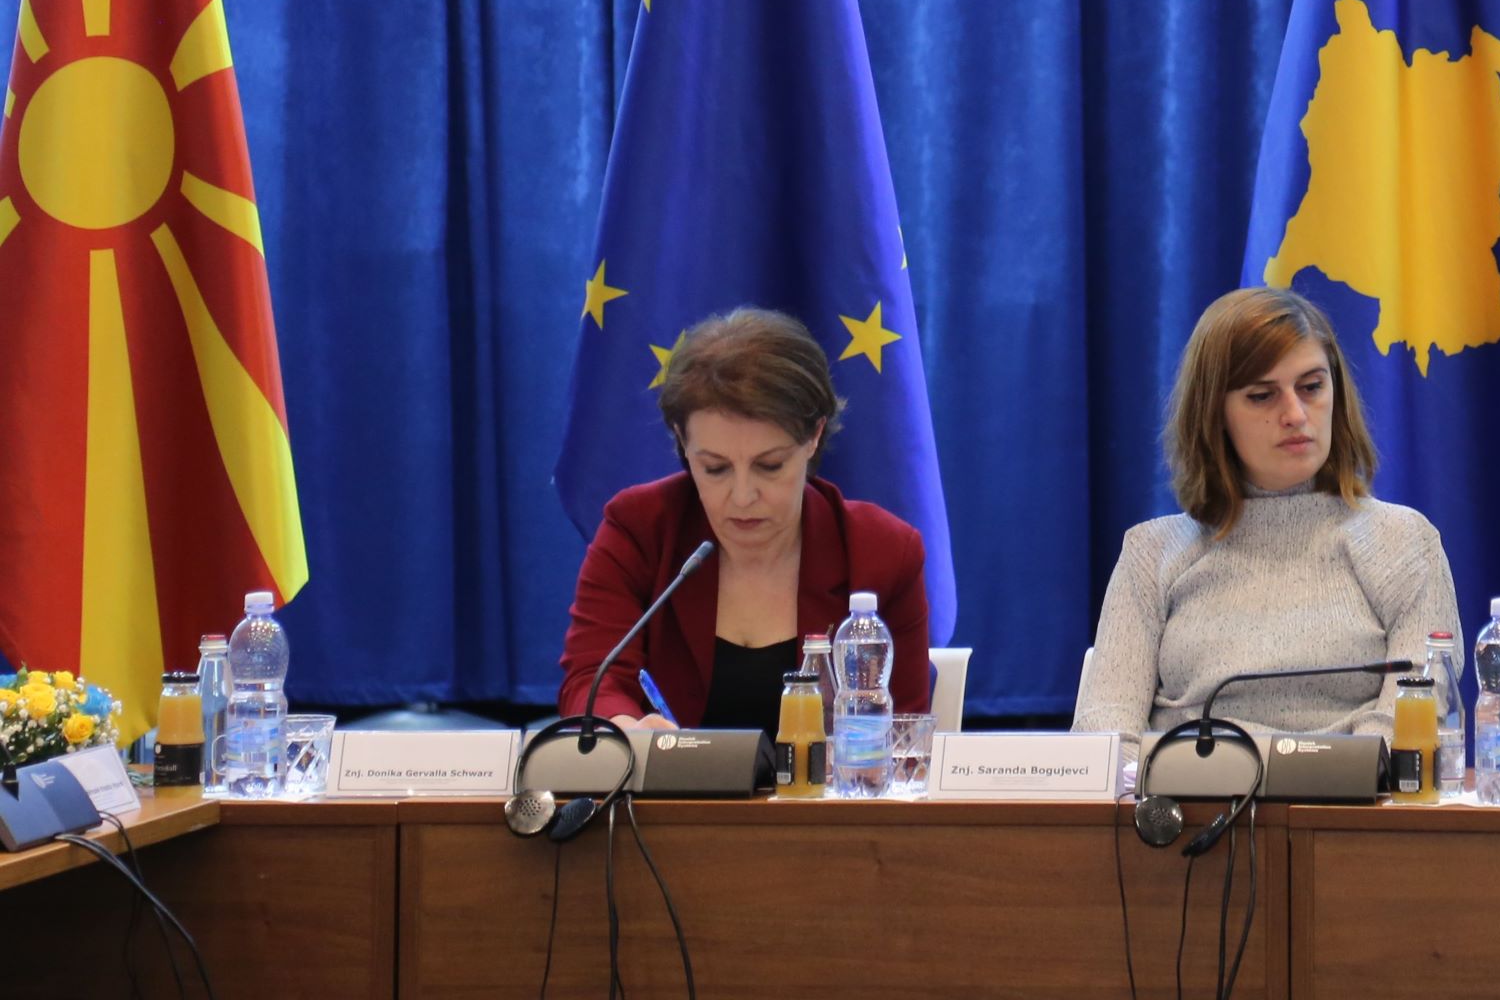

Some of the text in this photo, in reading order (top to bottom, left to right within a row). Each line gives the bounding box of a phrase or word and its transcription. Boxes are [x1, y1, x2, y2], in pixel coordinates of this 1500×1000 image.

[367, 769, 402, 778] Donika
[405, 769, 447, 778] Gervalla
[450, 769, 494, 778] Schwarz
[951, 765, 1089, 777] Znj. Saranda Bogujevci
